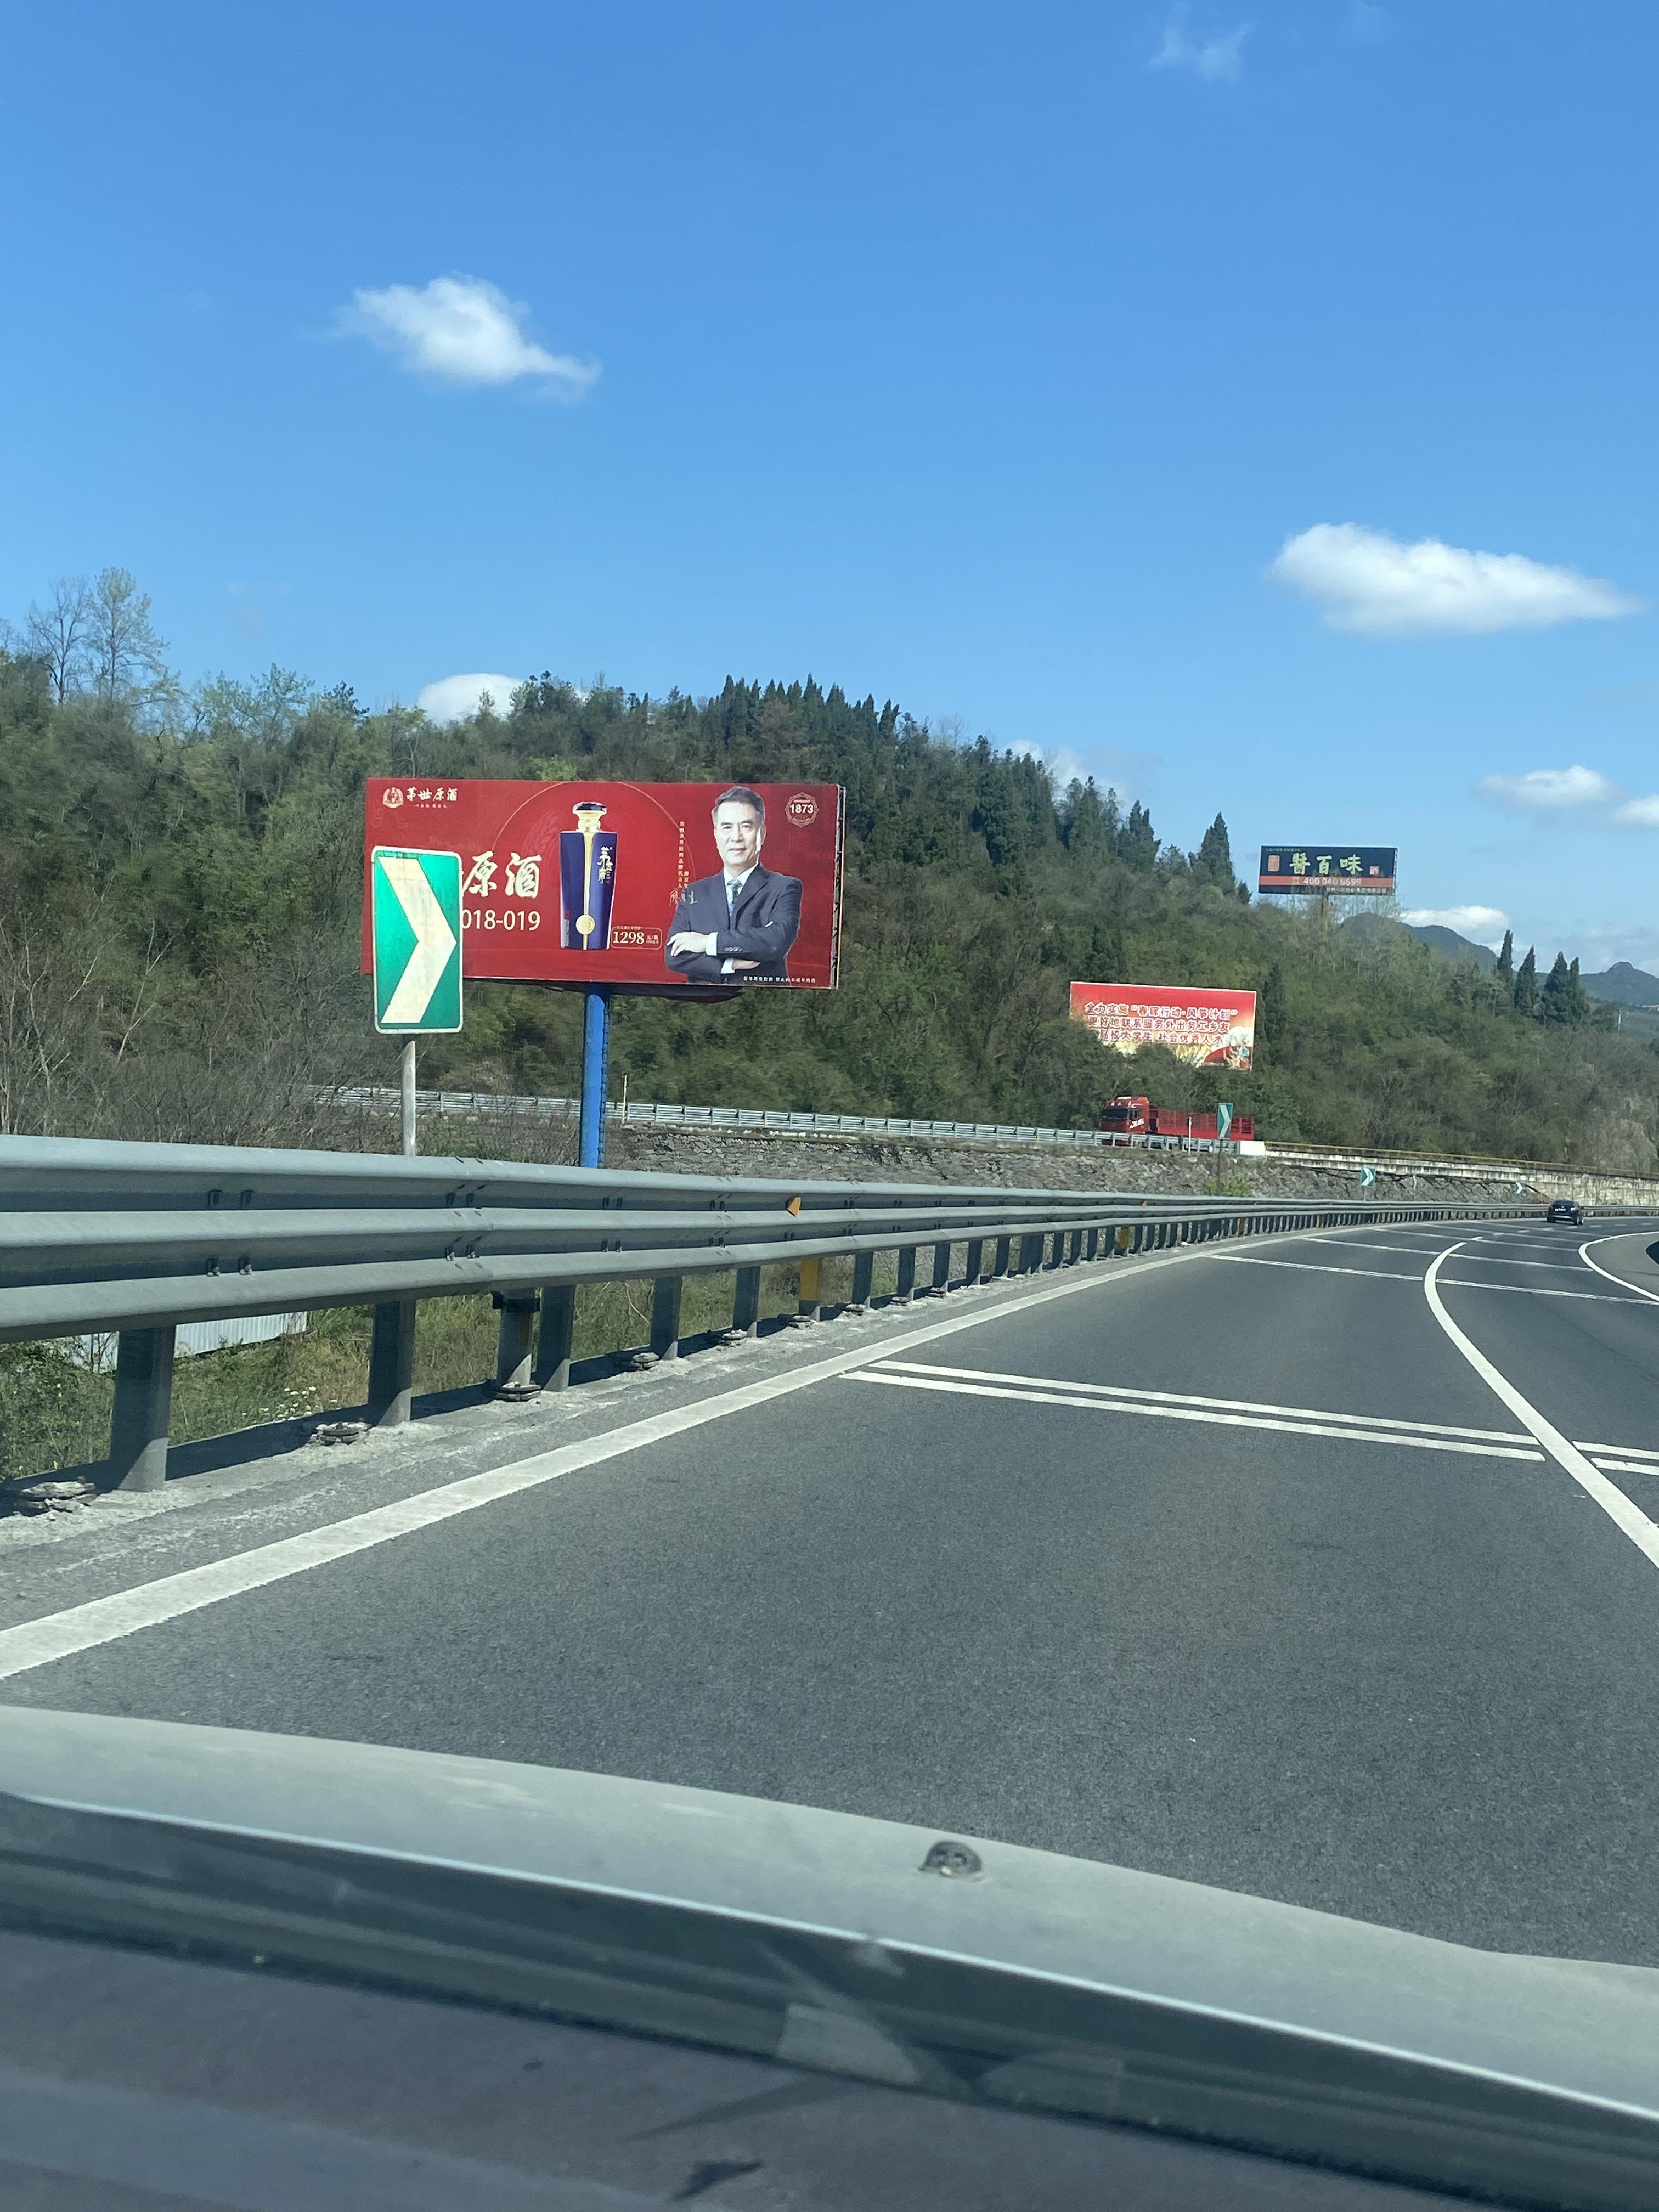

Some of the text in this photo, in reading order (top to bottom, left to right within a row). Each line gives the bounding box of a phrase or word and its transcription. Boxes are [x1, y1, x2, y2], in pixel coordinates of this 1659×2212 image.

[790, 804, 814, 814] 1873
[462, 909, 540, 931] 018-019
[613, 931, 644, 944] 1298
